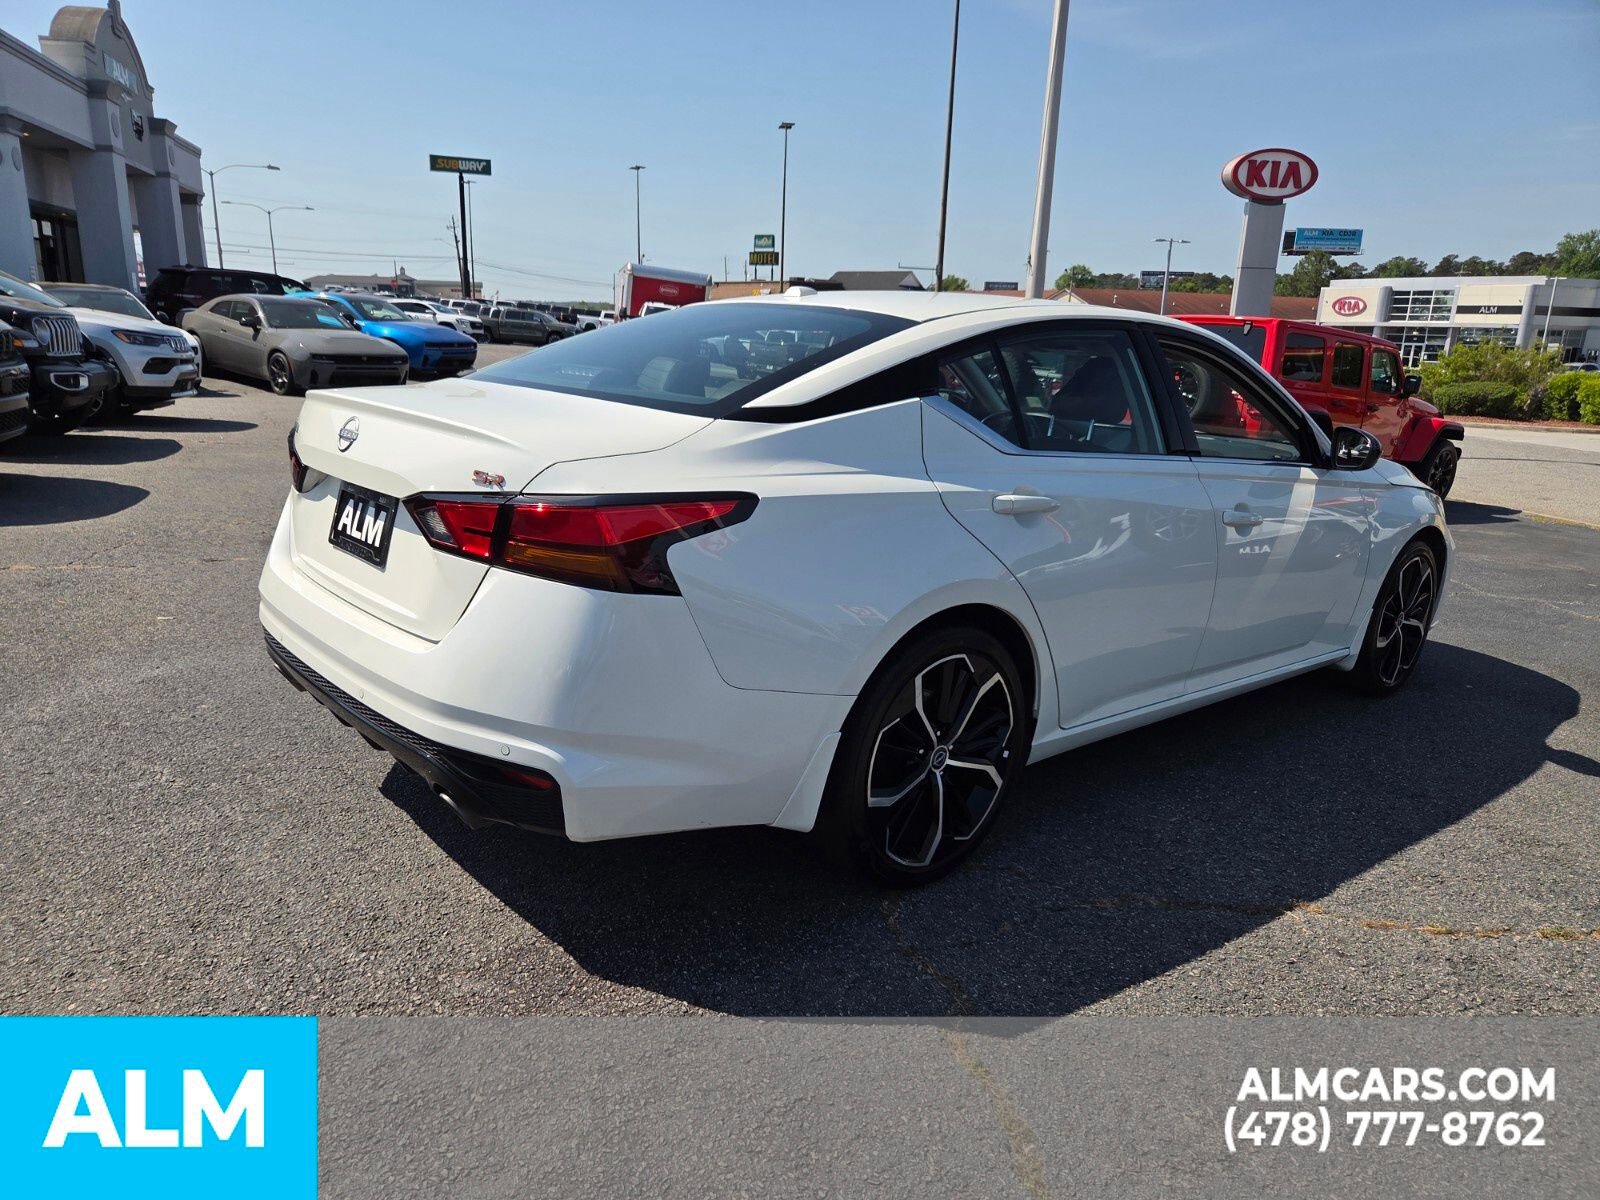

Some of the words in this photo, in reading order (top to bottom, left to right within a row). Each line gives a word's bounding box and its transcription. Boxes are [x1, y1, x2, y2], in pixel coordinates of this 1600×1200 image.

[436, 158, 486, 171] SUBWAY
[1246, 160, 1302, 188] KIA
[750, 253, 778, 264] MOTEL
[1337, 300, 1361, 313] KIA
[1478, 306, 1498, 314] ALM
[337, 498, 387, 548] ALM
